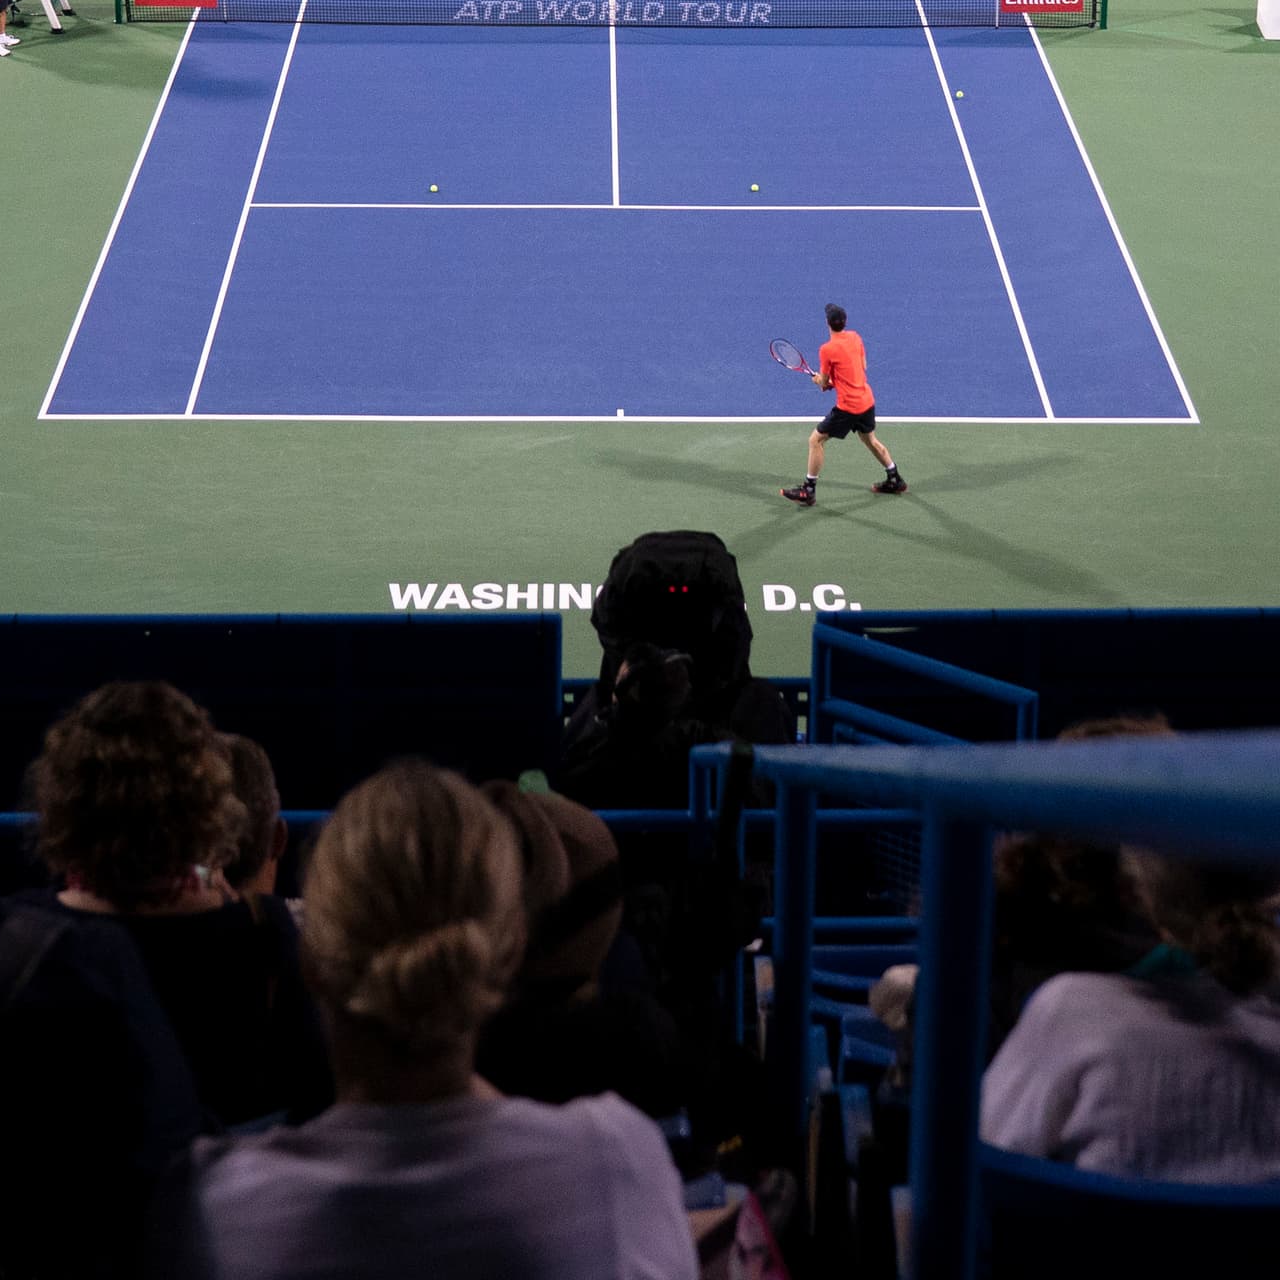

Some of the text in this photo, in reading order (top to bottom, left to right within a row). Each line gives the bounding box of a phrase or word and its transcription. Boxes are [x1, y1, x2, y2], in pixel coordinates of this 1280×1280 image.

[453, 0, 772, 23] ATP WORLD TOUR
[388, 582, 862, 611] WASHIN D.C.
